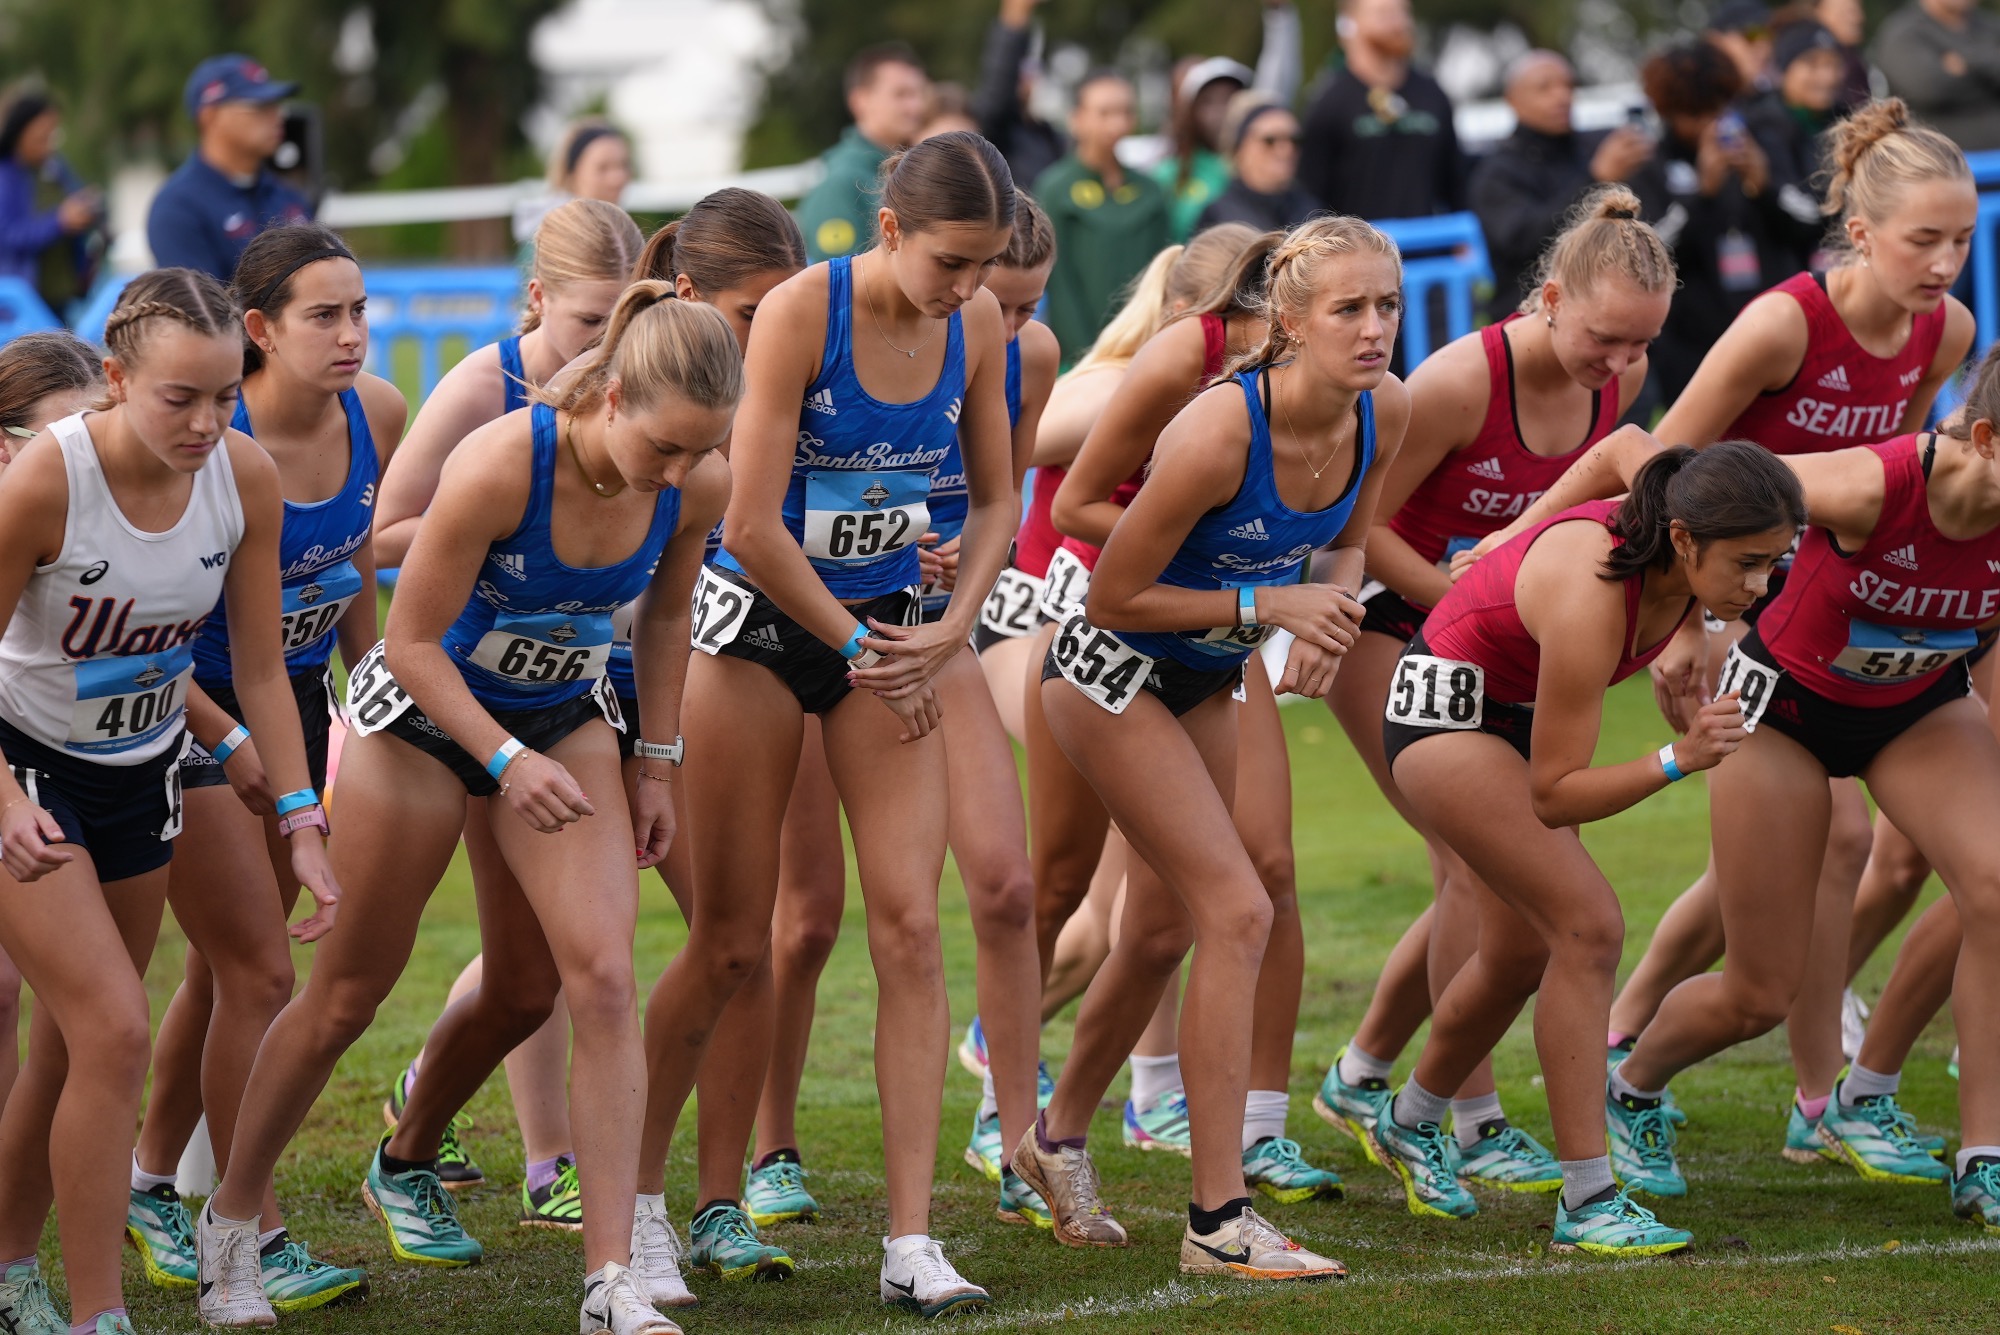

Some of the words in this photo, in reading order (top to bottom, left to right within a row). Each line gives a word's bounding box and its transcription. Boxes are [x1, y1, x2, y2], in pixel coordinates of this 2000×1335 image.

[800, 399, 837, 416] adidas
[1786, 397, 1908, 437] SEATTLE
[1462, 488, 1547, 517] SEAT
[829, 510, 910, 558] 652
[1228, 529, 1270, 541] adidas
[488, 553, 528, 582] adidas
[1882, 553, 1919, 571] adidas
[1043, 556, 1091, 614] 51
[1849, 569, 2000, 620] SEATTLE
[691, 573, 742, 649] 652
[498, 638, 590, 681] 656
[743, 634, 785, 652] adidas
[1057, 614, 1145, 706] 654
[1861, 651, 1948, 678] 519
[96, 679, 176, 738] 400
[1394, 660, 1476, 722] 518
[180, 757, 219, 767] didas
